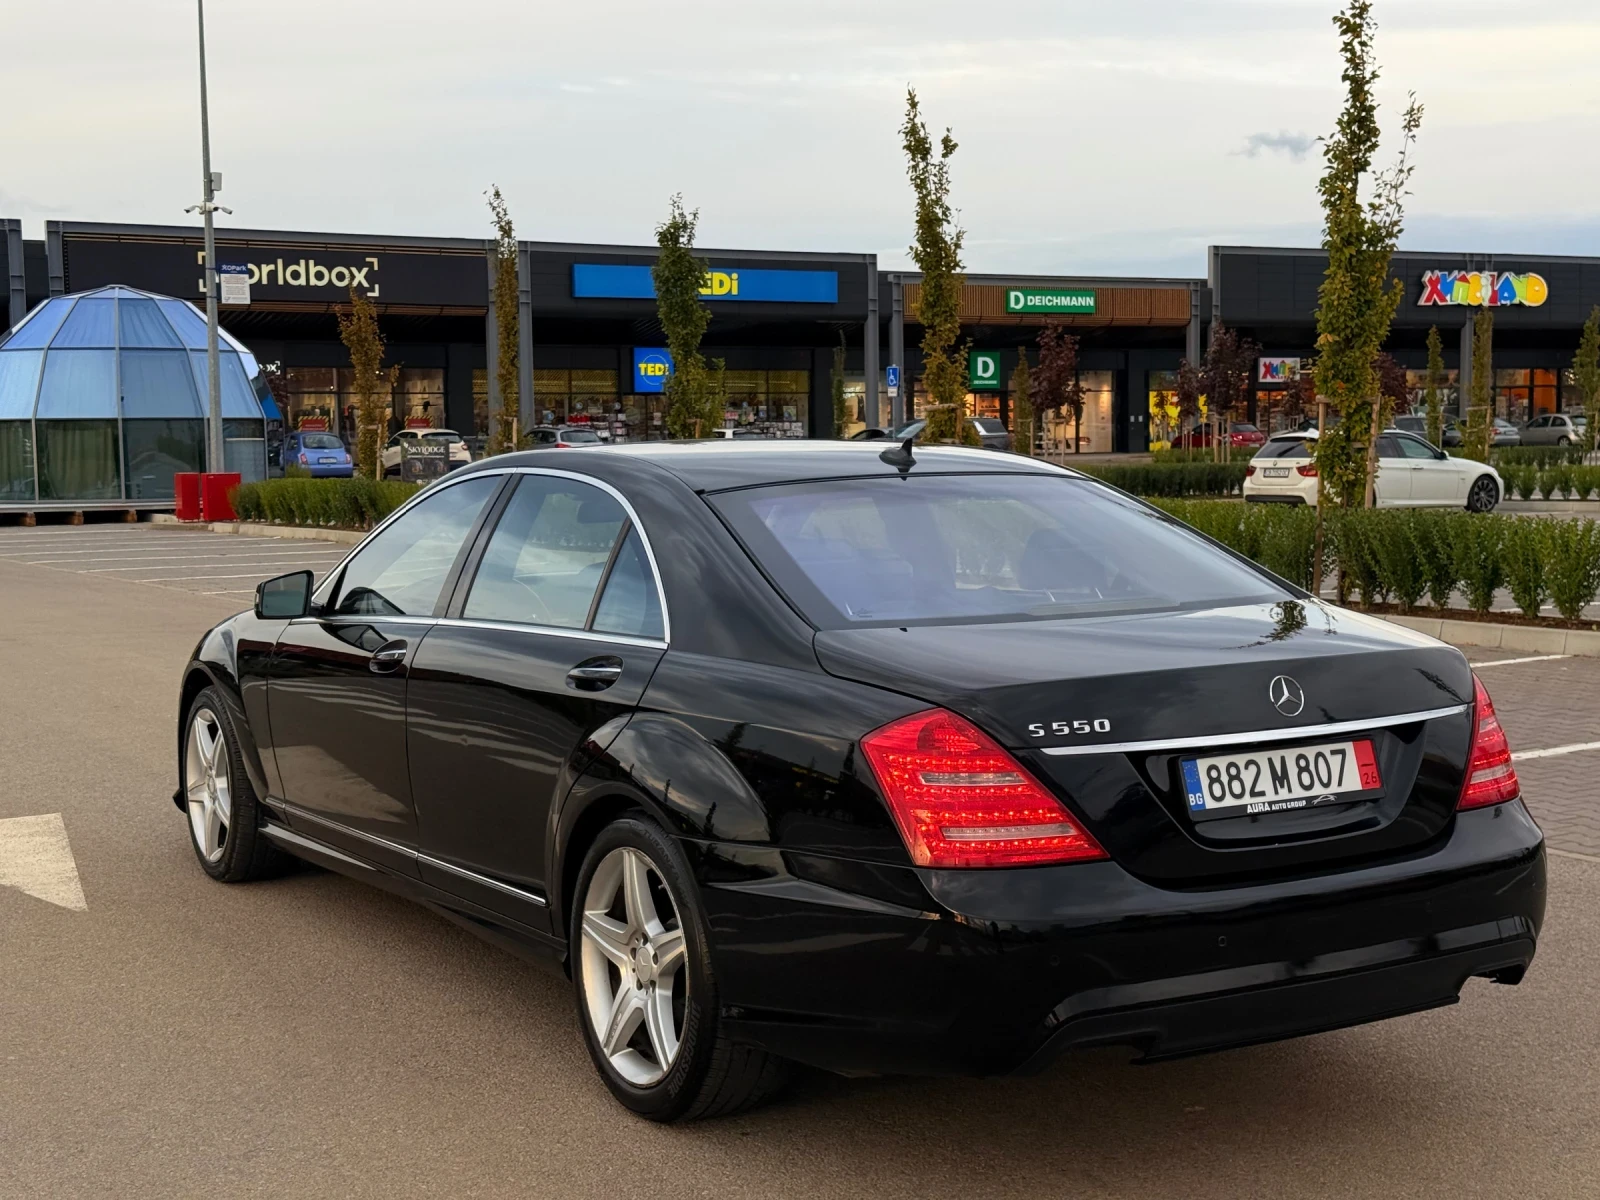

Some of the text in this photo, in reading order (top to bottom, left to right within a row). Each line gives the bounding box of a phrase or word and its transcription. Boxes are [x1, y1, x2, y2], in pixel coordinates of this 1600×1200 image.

[215, 258, 370, 288] orldbox
[698, 272, 738, 295] EDi
[1027, 295, 1094, 307] DEICHMANN
[638, 363, 670, 376] TEDi
[977, 356, 995, 378] D
[407, 446, 446, 455] SKYLODGE
[1028, 718, 1111, 737] S 550
[1363, 772, 1379, 785] 26
[1188, 792, 1204, 806] BG
[1246, 800, 1307, 814] AURA AUTO GROUP
